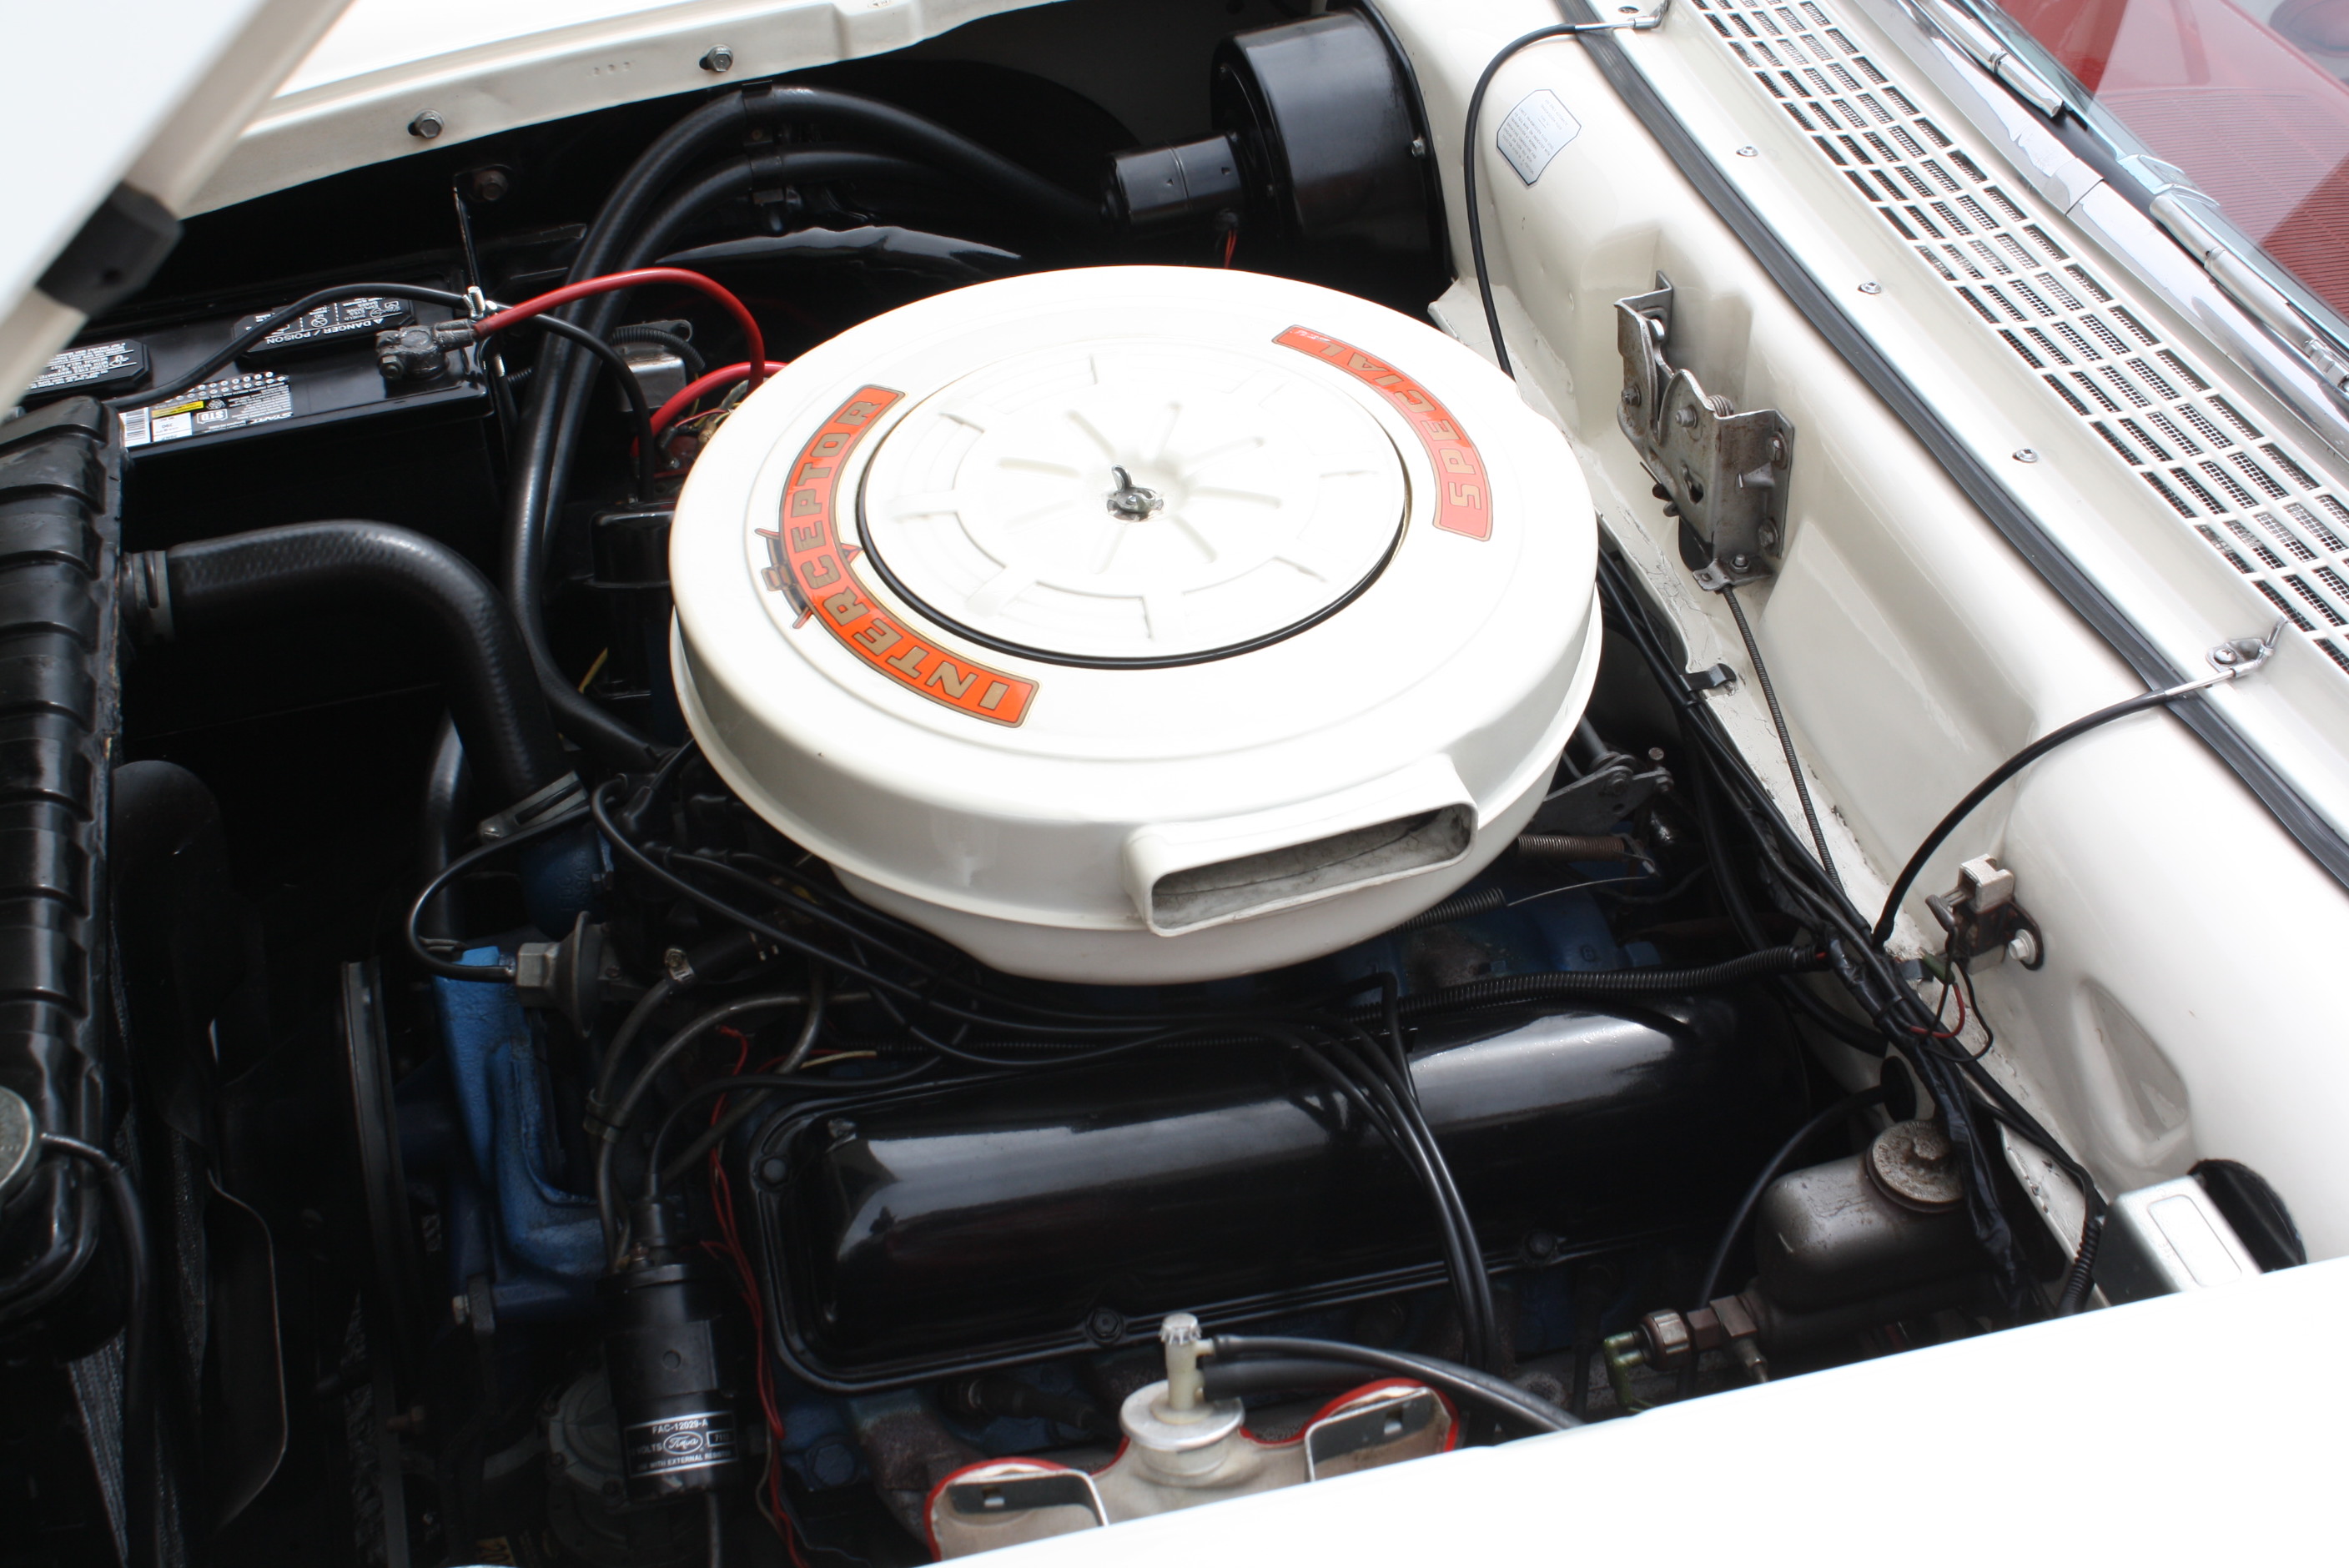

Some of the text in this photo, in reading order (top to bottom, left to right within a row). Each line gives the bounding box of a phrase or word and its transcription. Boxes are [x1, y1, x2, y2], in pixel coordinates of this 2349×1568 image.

[324, 320, 371, 334] DANGER
[266, 331, 309, 344] POISON
[1318, 339, 1481, 510] SPECIAL
[790, 400, 1010, 711] INTERCEPTOR
[667, 1455, 703, 1466] EXTERNAL
